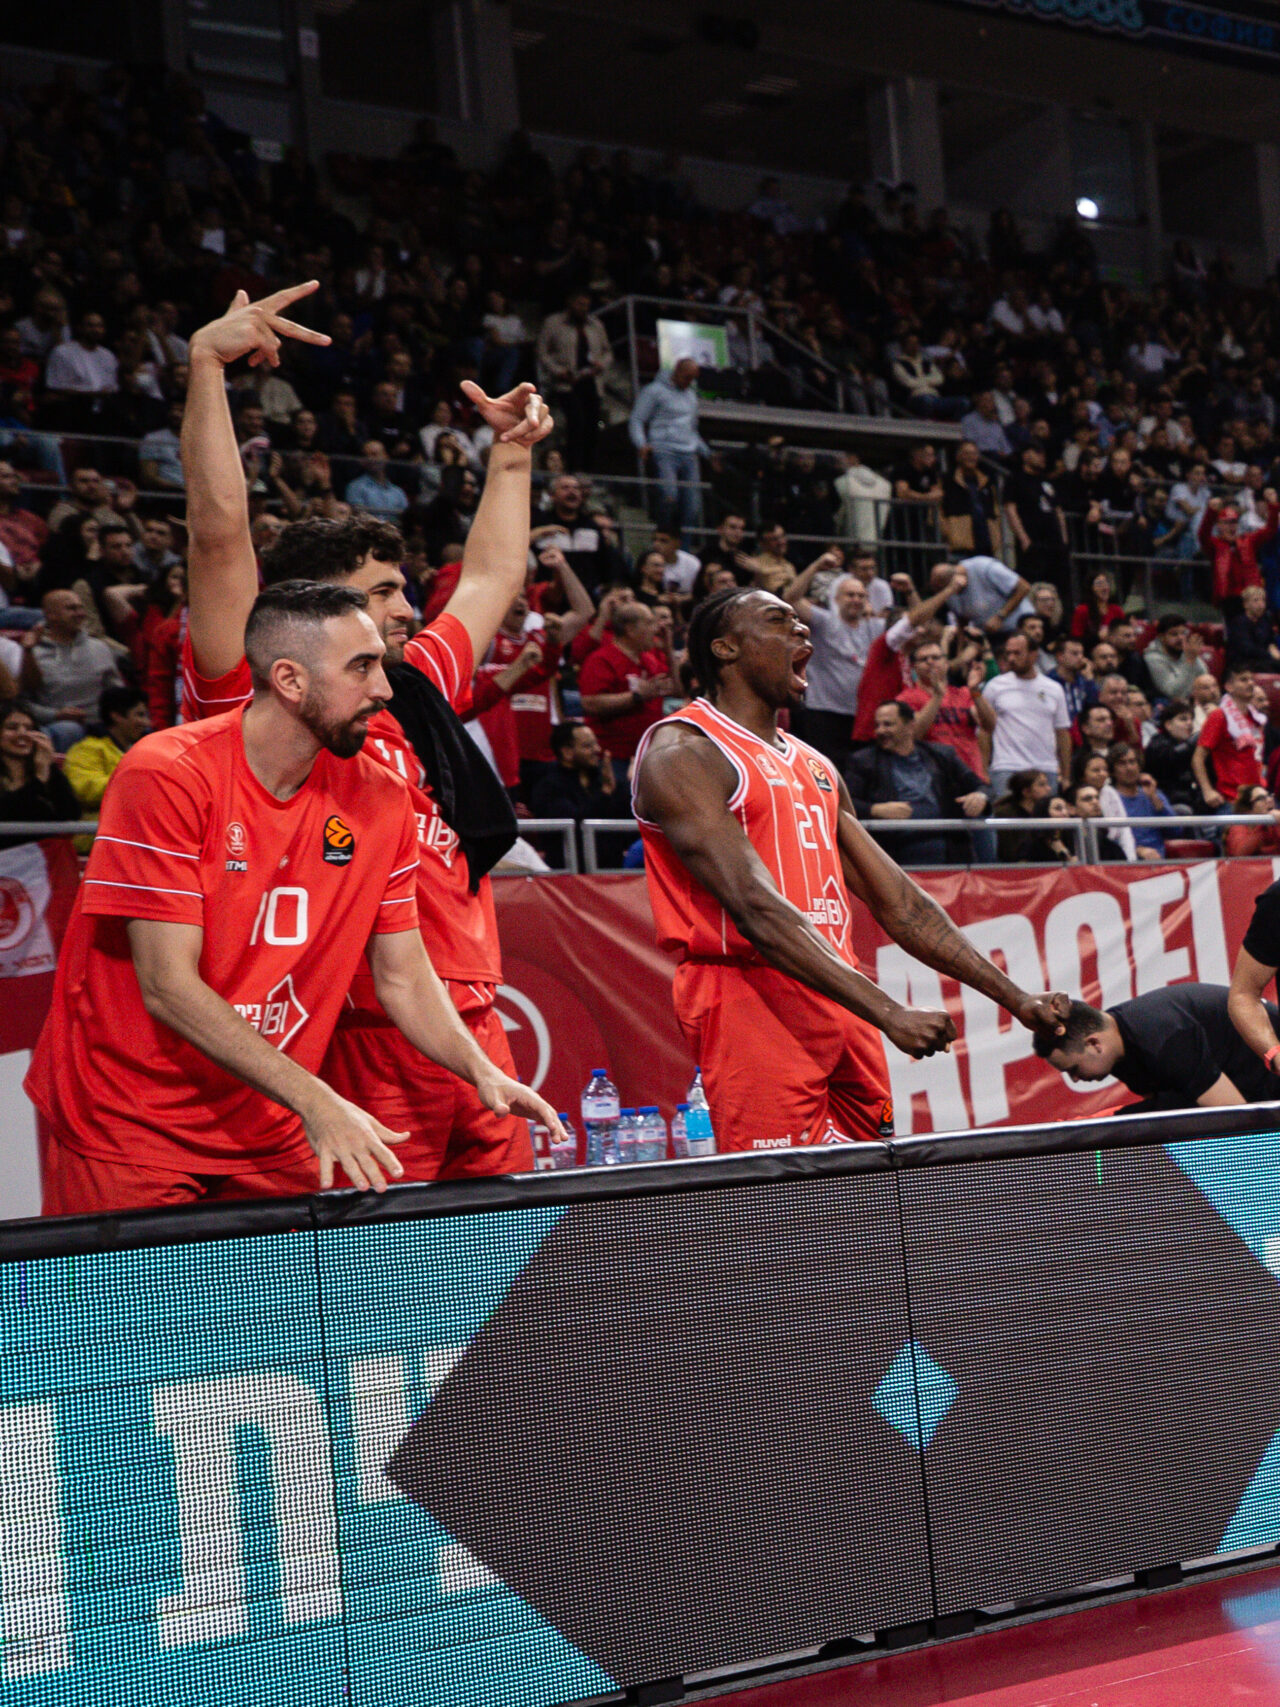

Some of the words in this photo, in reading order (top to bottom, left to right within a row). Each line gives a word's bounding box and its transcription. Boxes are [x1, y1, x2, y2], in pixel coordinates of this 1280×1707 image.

[1164, 6, 1276, 49] СОФИЯ
[794, 802, 832, 850] 21
[249, 886, 309, 946] 10
[260, 1000, 290, 1036] IBI
[752, 1134, 792, 1149] nuvei
[152, 1346, 502, 1653] ית
